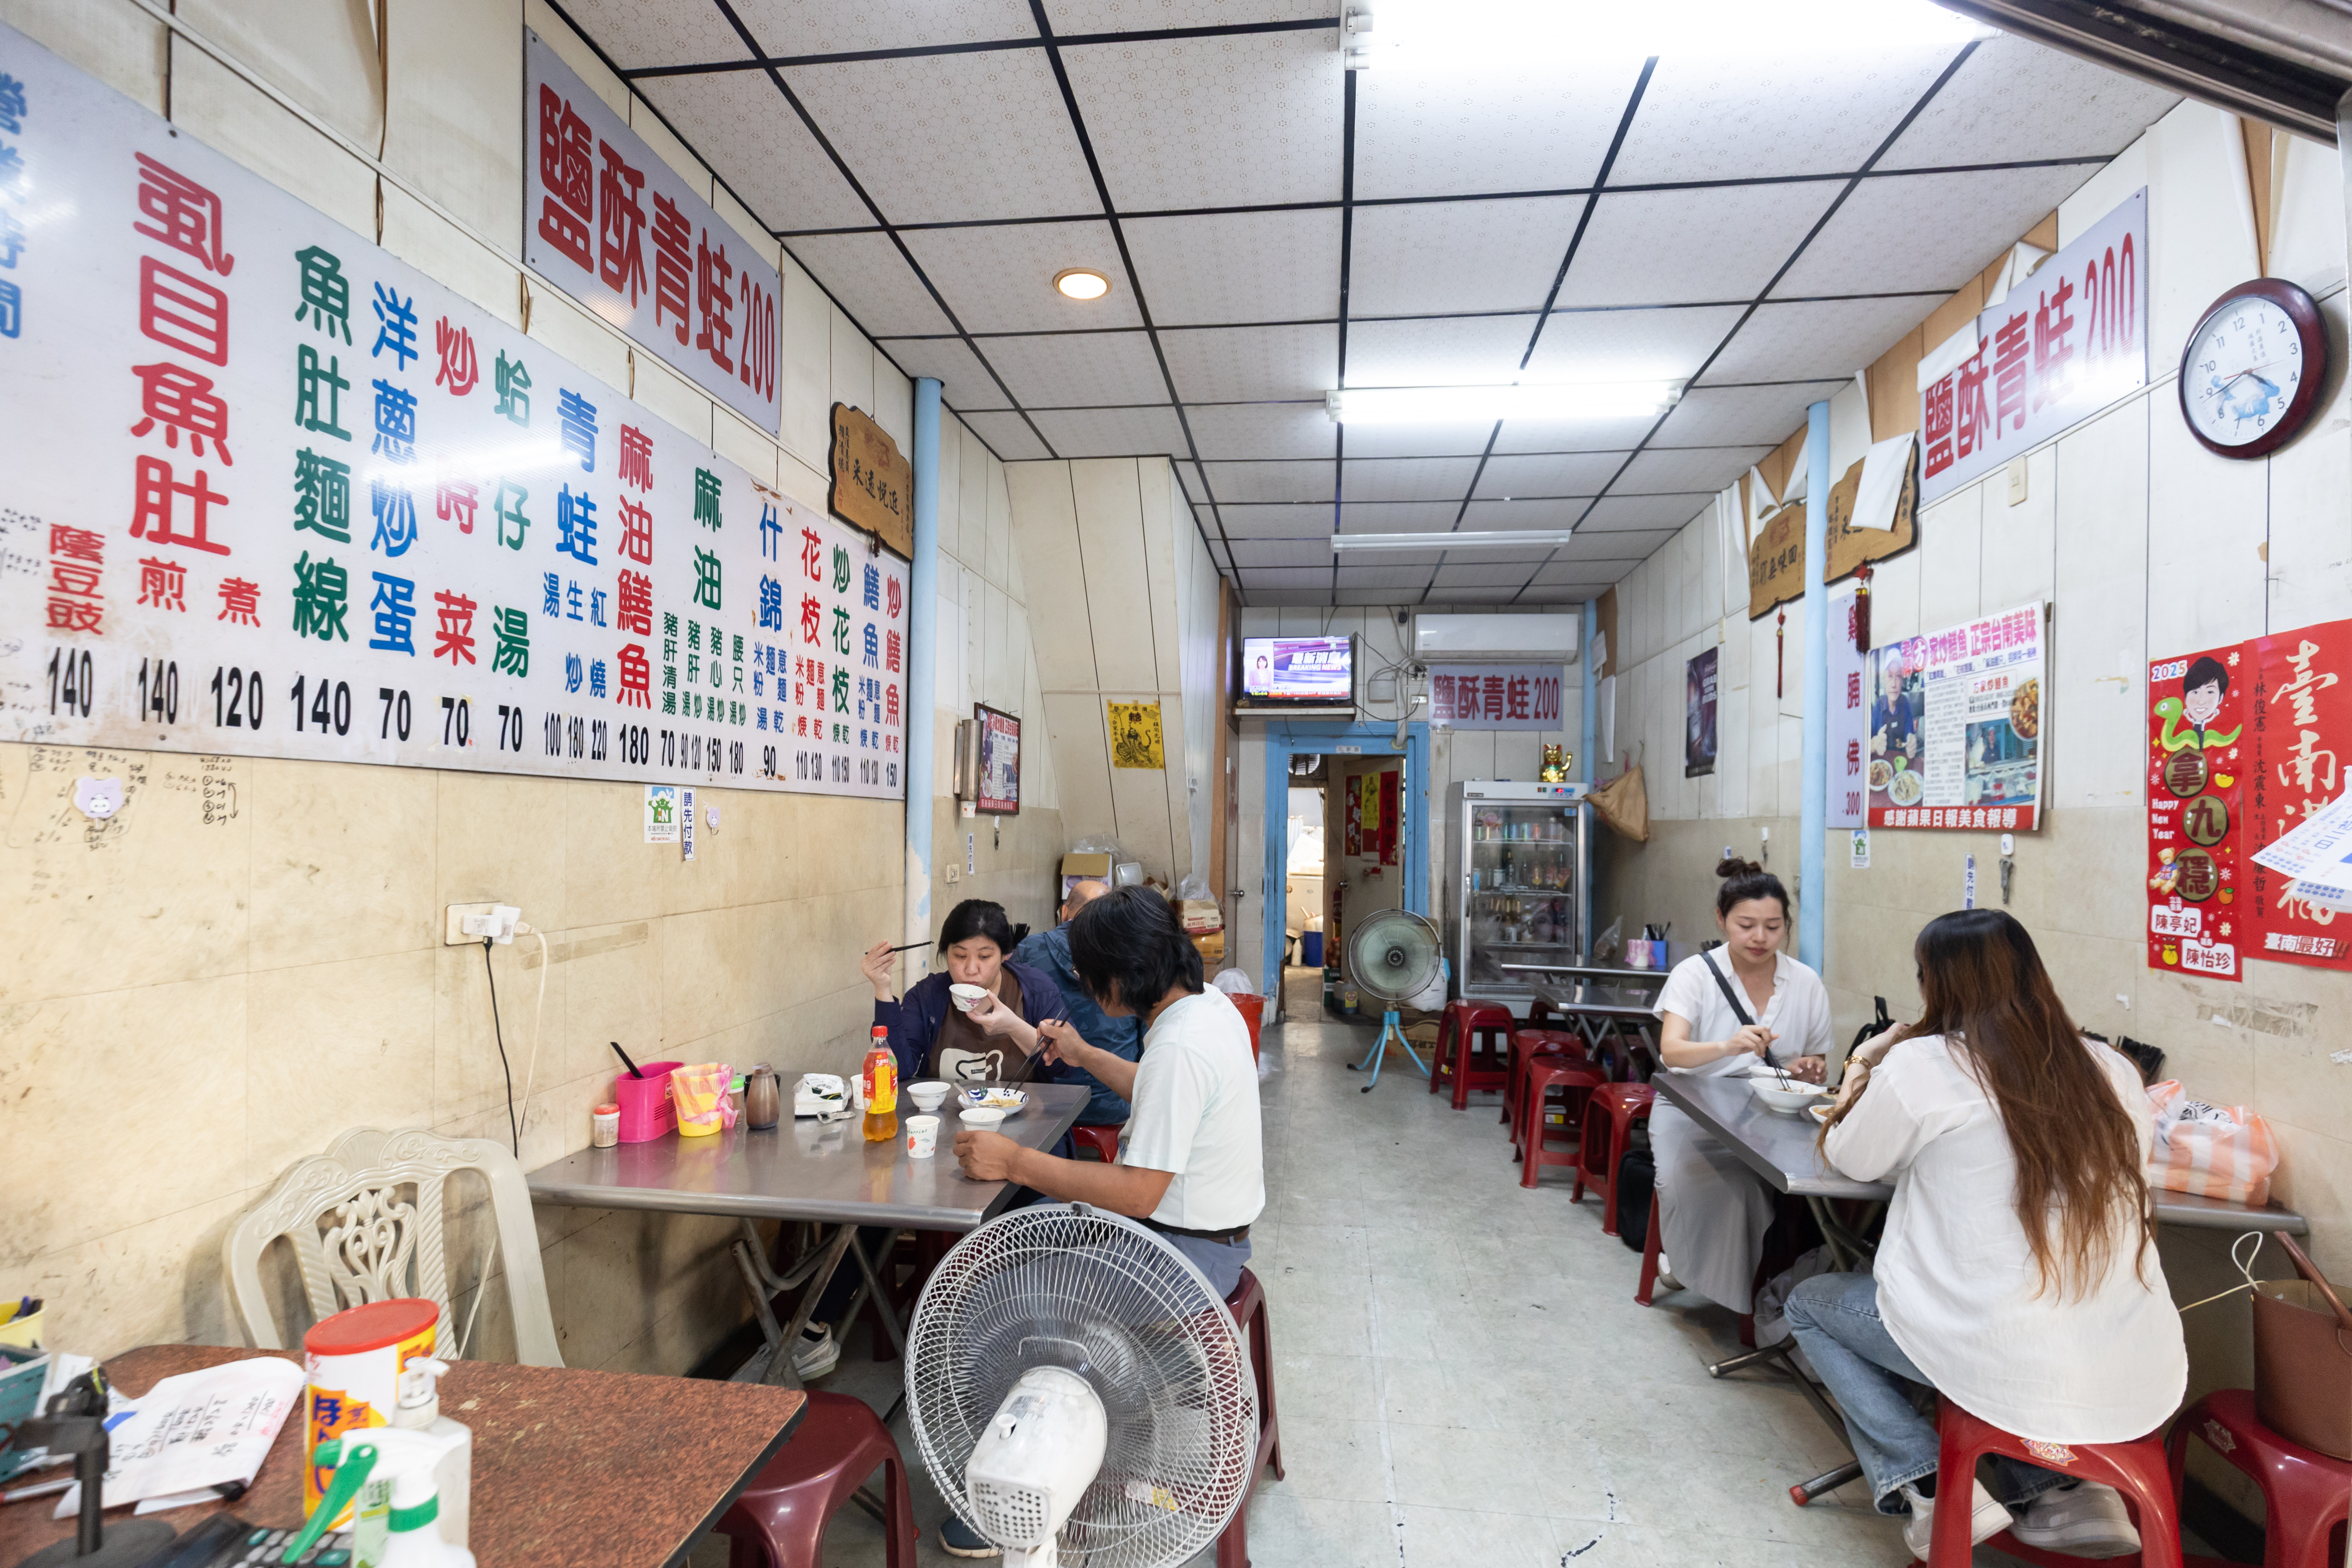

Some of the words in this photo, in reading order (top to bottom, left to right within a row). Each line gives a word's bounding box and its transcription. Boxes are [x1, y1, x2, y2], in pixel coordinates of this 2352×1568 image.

[538, 83, 733, 375] 鹽酥青蛙
[740, 271, 775, 404] 200
[2233, 317, 2245, 331] 12
[2259, 313, 2264, 324] 1
[2278, 321, 2287, 334] 2
[129, 151, 234, 556] 虱目魚肚
[2217, 336, 2225, 349] 11
[2290, 343, 2298, 355] 3
[2205, 360, 2216, 374] 10
[2290, 371, 2297, 382] 4
[2218, 406, 2224, 419] 8
[2234, 416, 2241, 429] 7
[2257, 414, 2264, 426] 6
[2278, 397, 2285, 409] 5
[292, 245, 352, 642] 魚肚麵線
[369, 281, 420, 657] 洋蔥炒蛋
[555, 388, 599, 566] 青蛙
[492, 349, 532, 678] 蛤仔湯
[693, 466, 723, 611] 麻油
[137, 556, 187, 612] 煎
[616, 423, 653, 710] 麻油鱔魚
[759, 502, 783, 633] 什錦
[800, 526, 822, 648] 花枝
[217, 577, 261, 628] 煮
[543, 571, 560, 618] 湯
[832, 543, 851, 715] 炒花枝
[863, 563, 879, 670] 鱔魚
[662, 612, 678, 715] 豬肝清湯
[687, 619, 701, 684] 豬肝
[710, 626, 723, 688] 豬心
[885, 574, 901, 728] 炒鱔魚
[1292, 651, 1341, 664] 最新消息
[2151, 661, 2188, 681] 2025
[48, 647, 92, 718] 140
[138, 657, 178, 724] 140
[211, 666, 263, 730] 120
[1433, 674, 1529, 721] 鹽酥青蛙
[1534, 677, 1559, 720] 200
[291, 675, 351, 736] 140
[379, 688, 411, 741] 70
[441, 697, 469, 747] 70
[498, 705, 523, 752] 70
[544, 712, 561, 757] 100
[568, 716, 584, 759] 180
[591, 719, 607, 761] 220
[619, 723, 649, 765] 180
[661, 729, 675, 767] 70
[680, 732, 688, 769] 90
[691, 734, 701, 771] 120
[707, 737, 721, 772] 150
[729, 740, 743, 775] 180
[763, 745, 776, 777] 90
[796, 750, 808, 781] 110
[811, 751, 822, 781] 130
[861, 758, 869, 784] 110
[886, 763, 897, 787] 150
[683, 792, 692, 855] 請先付款
[1883, 808, 2018, 828] 感謝蘋果日報美食報導
[2152, 798, 2179, 811] Happy
[2152, 814, 2168, 825] New
[2153, 828, 2174, 840] Year
[2156, 914, 2196, 933] 陳亭妃
[2186, 948, 2231, 969] 陳怡珍
